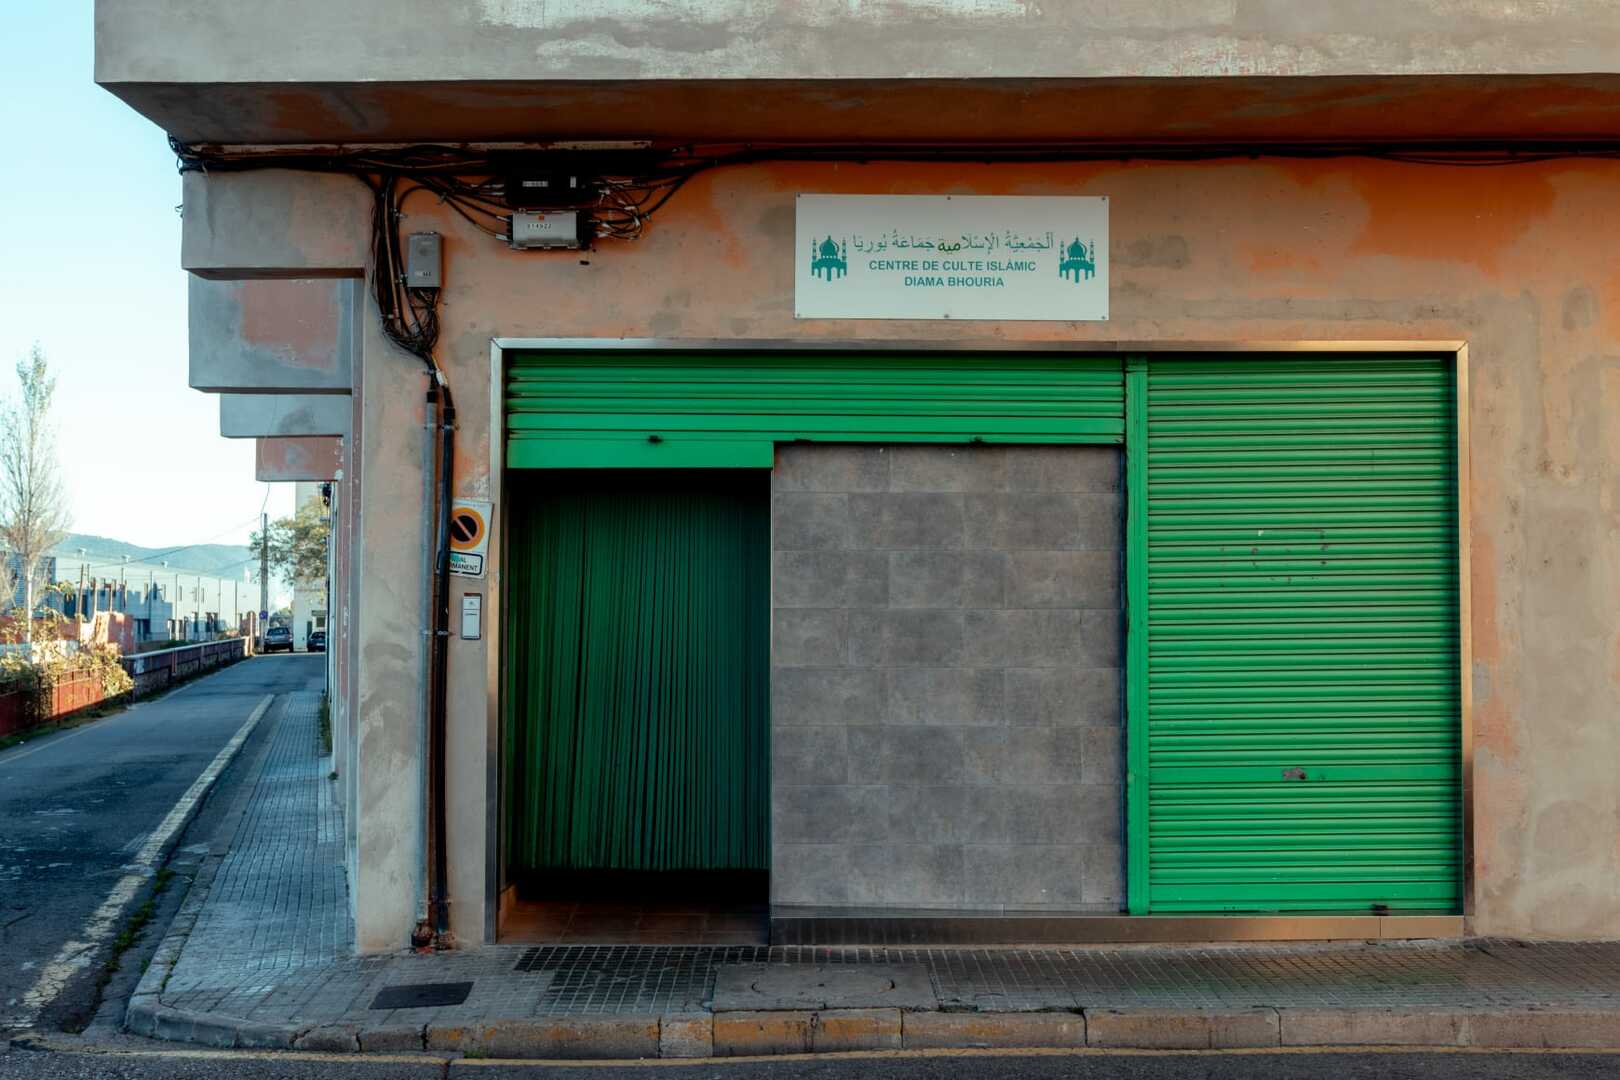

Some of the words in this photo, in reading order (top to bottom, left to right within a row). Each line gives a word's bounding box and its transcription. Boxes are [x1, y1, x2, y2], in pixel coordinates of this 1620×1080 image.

[869, 260, 919, 271] CENTRE
[922, 260, 938, 271] DE
[942, 260, 982, 271] CULTE
[904, 276, 944, 287] DIAMA
[948, 276, 1004, 287] BHOURIA
[450, 562, 478, 571] MANENT
